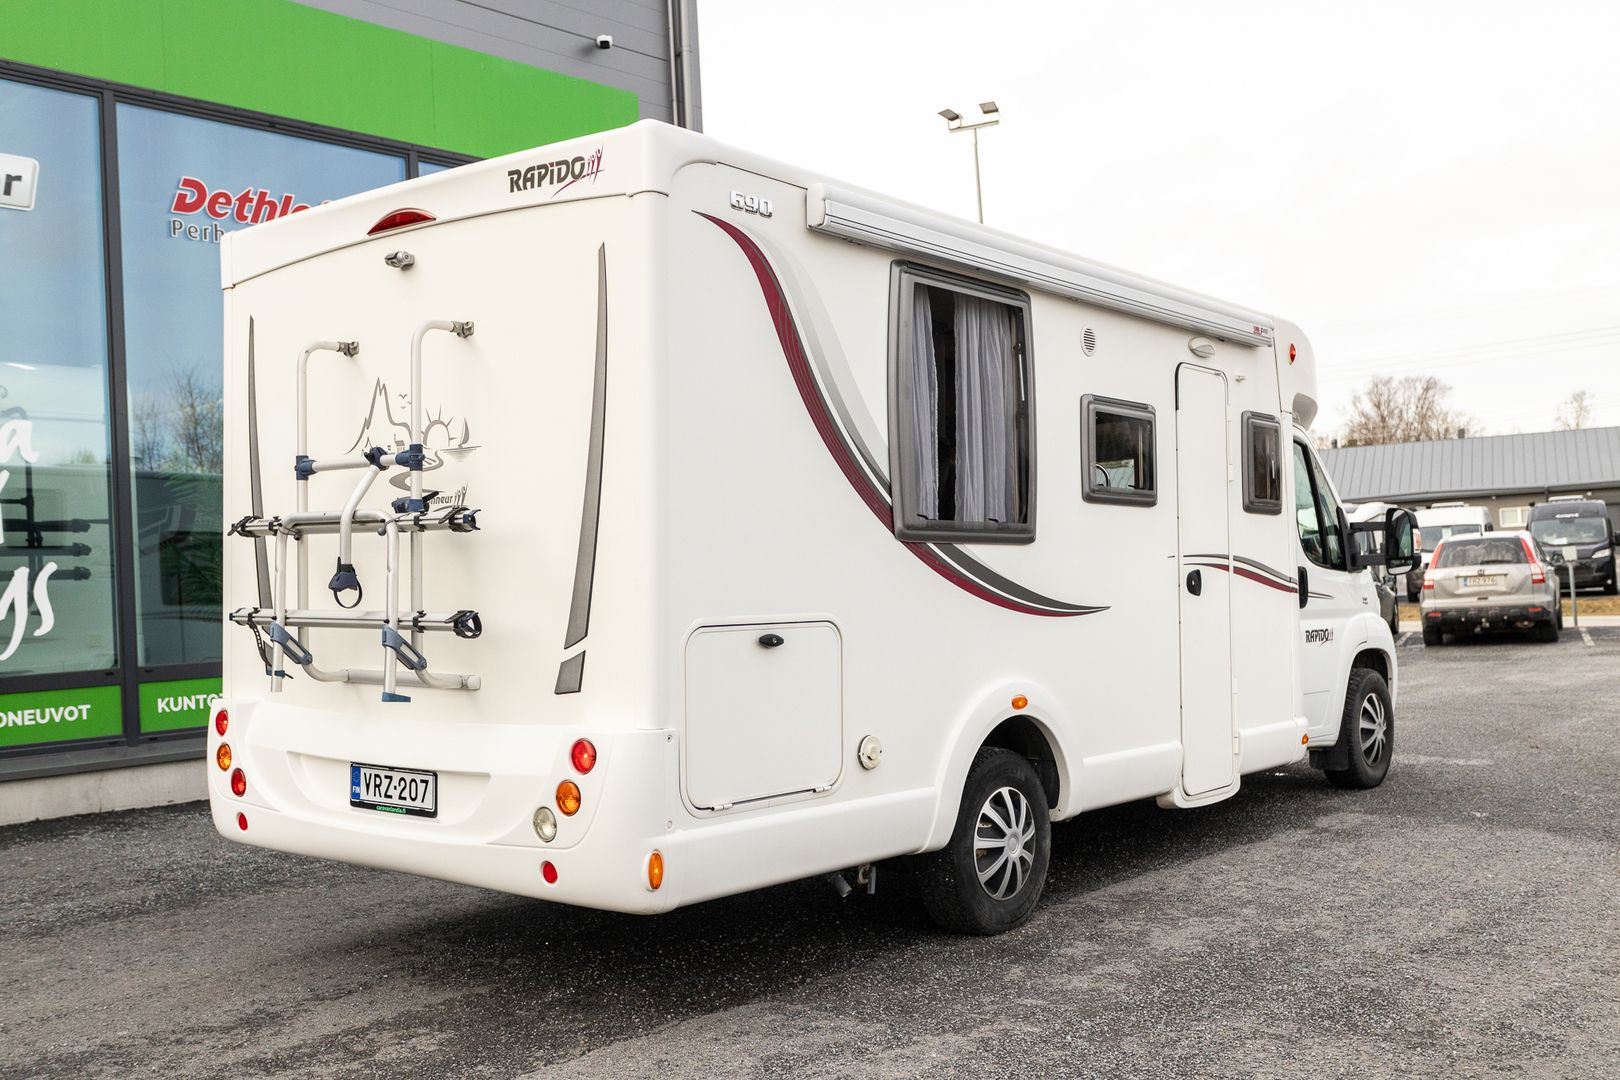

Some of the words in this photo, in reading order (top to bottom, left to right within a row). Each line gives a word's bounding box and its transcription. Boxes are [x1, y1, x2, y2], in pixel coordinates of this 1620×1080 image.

[508, 156, 586, 193] RAPIDO
[730, 190, 773, 218] 690
[428, 495, 453, 505] nneur
[1305, 629, 1330, 643] RAPIDO
[157, 692, 223, 713] KUNTO
[364, 772, 430, 803] VRZ-207
